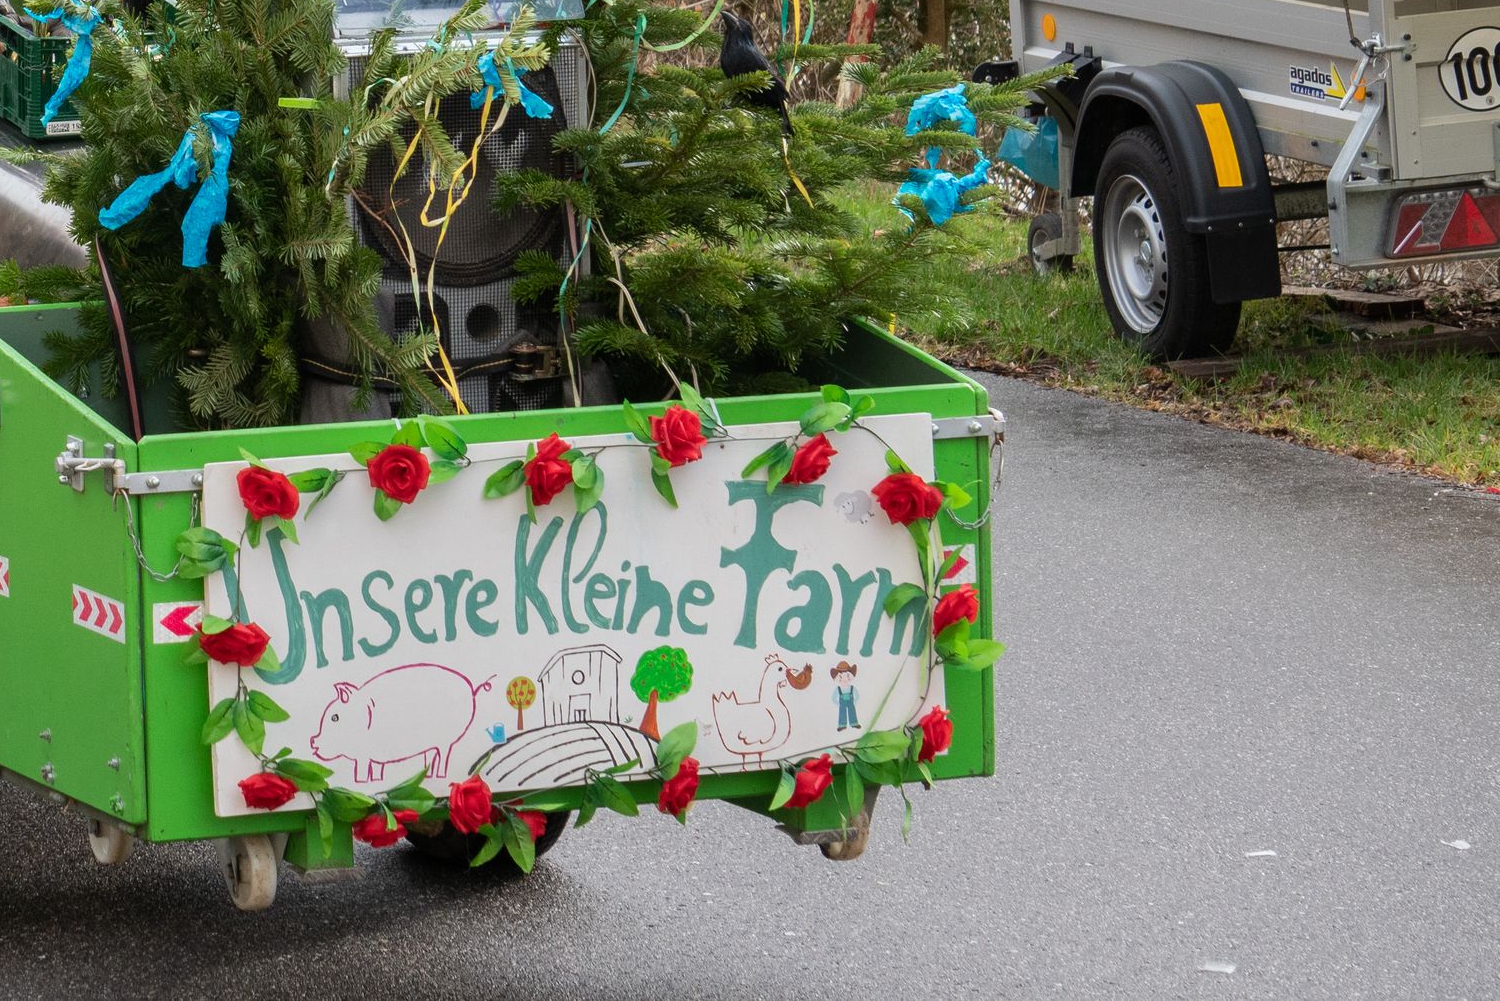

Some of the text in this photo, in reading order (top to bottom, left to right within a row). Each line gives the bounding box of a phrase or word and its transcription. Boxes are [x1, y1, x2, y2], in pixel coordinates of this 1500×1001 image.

[1290, 66, 1332, 86] agados
[1291, 84, 1325, 99] TRAILERS
[514, 501, 715, 639] Kleine
[719, 480, 930, 657] Farm
